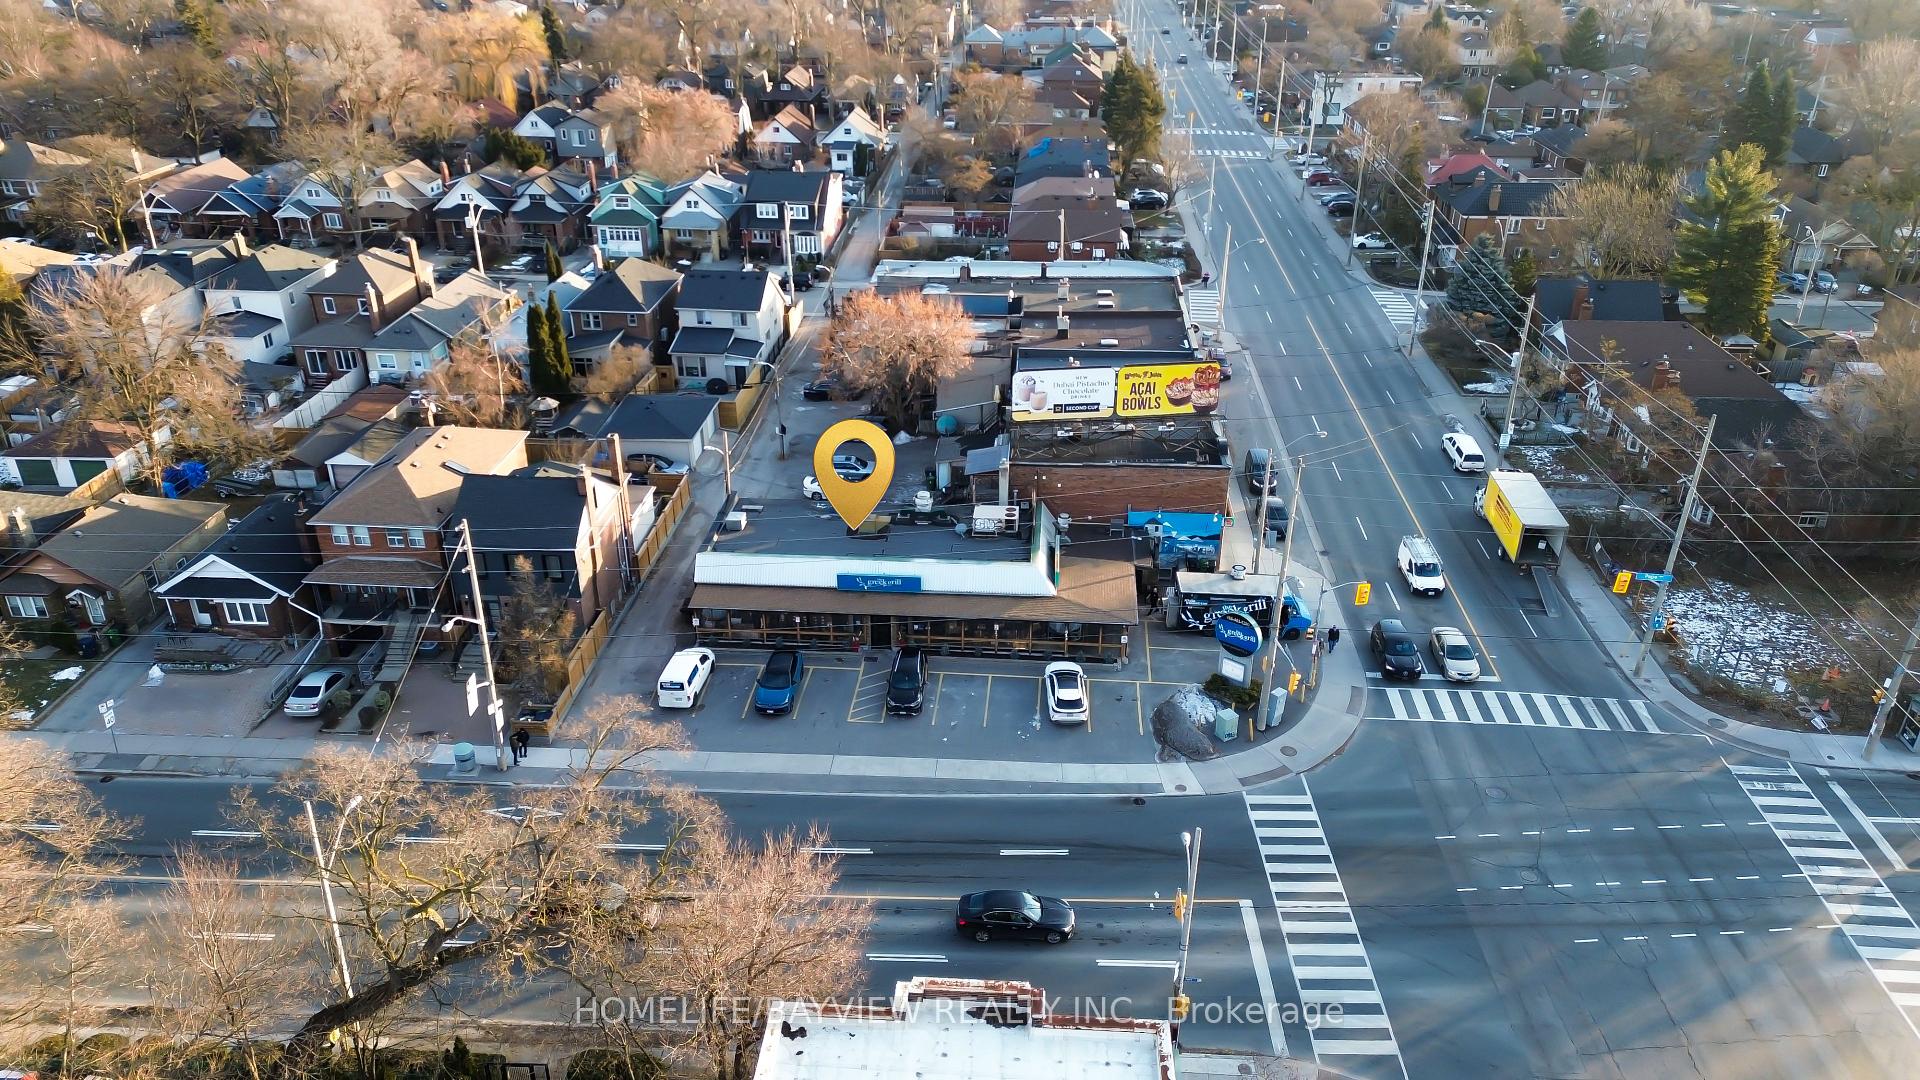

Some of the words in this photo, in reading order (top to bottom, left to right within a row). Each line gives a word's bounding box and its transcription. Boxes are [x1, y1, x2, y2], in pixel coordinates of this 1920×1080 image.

[1062, 387, 1100, 395] Chocolate
[1130, 382, 1156, 398] AÇAI
[1122, 396, 1162, 411] BOWLS
[1243, 597, 1267, 613] grill
